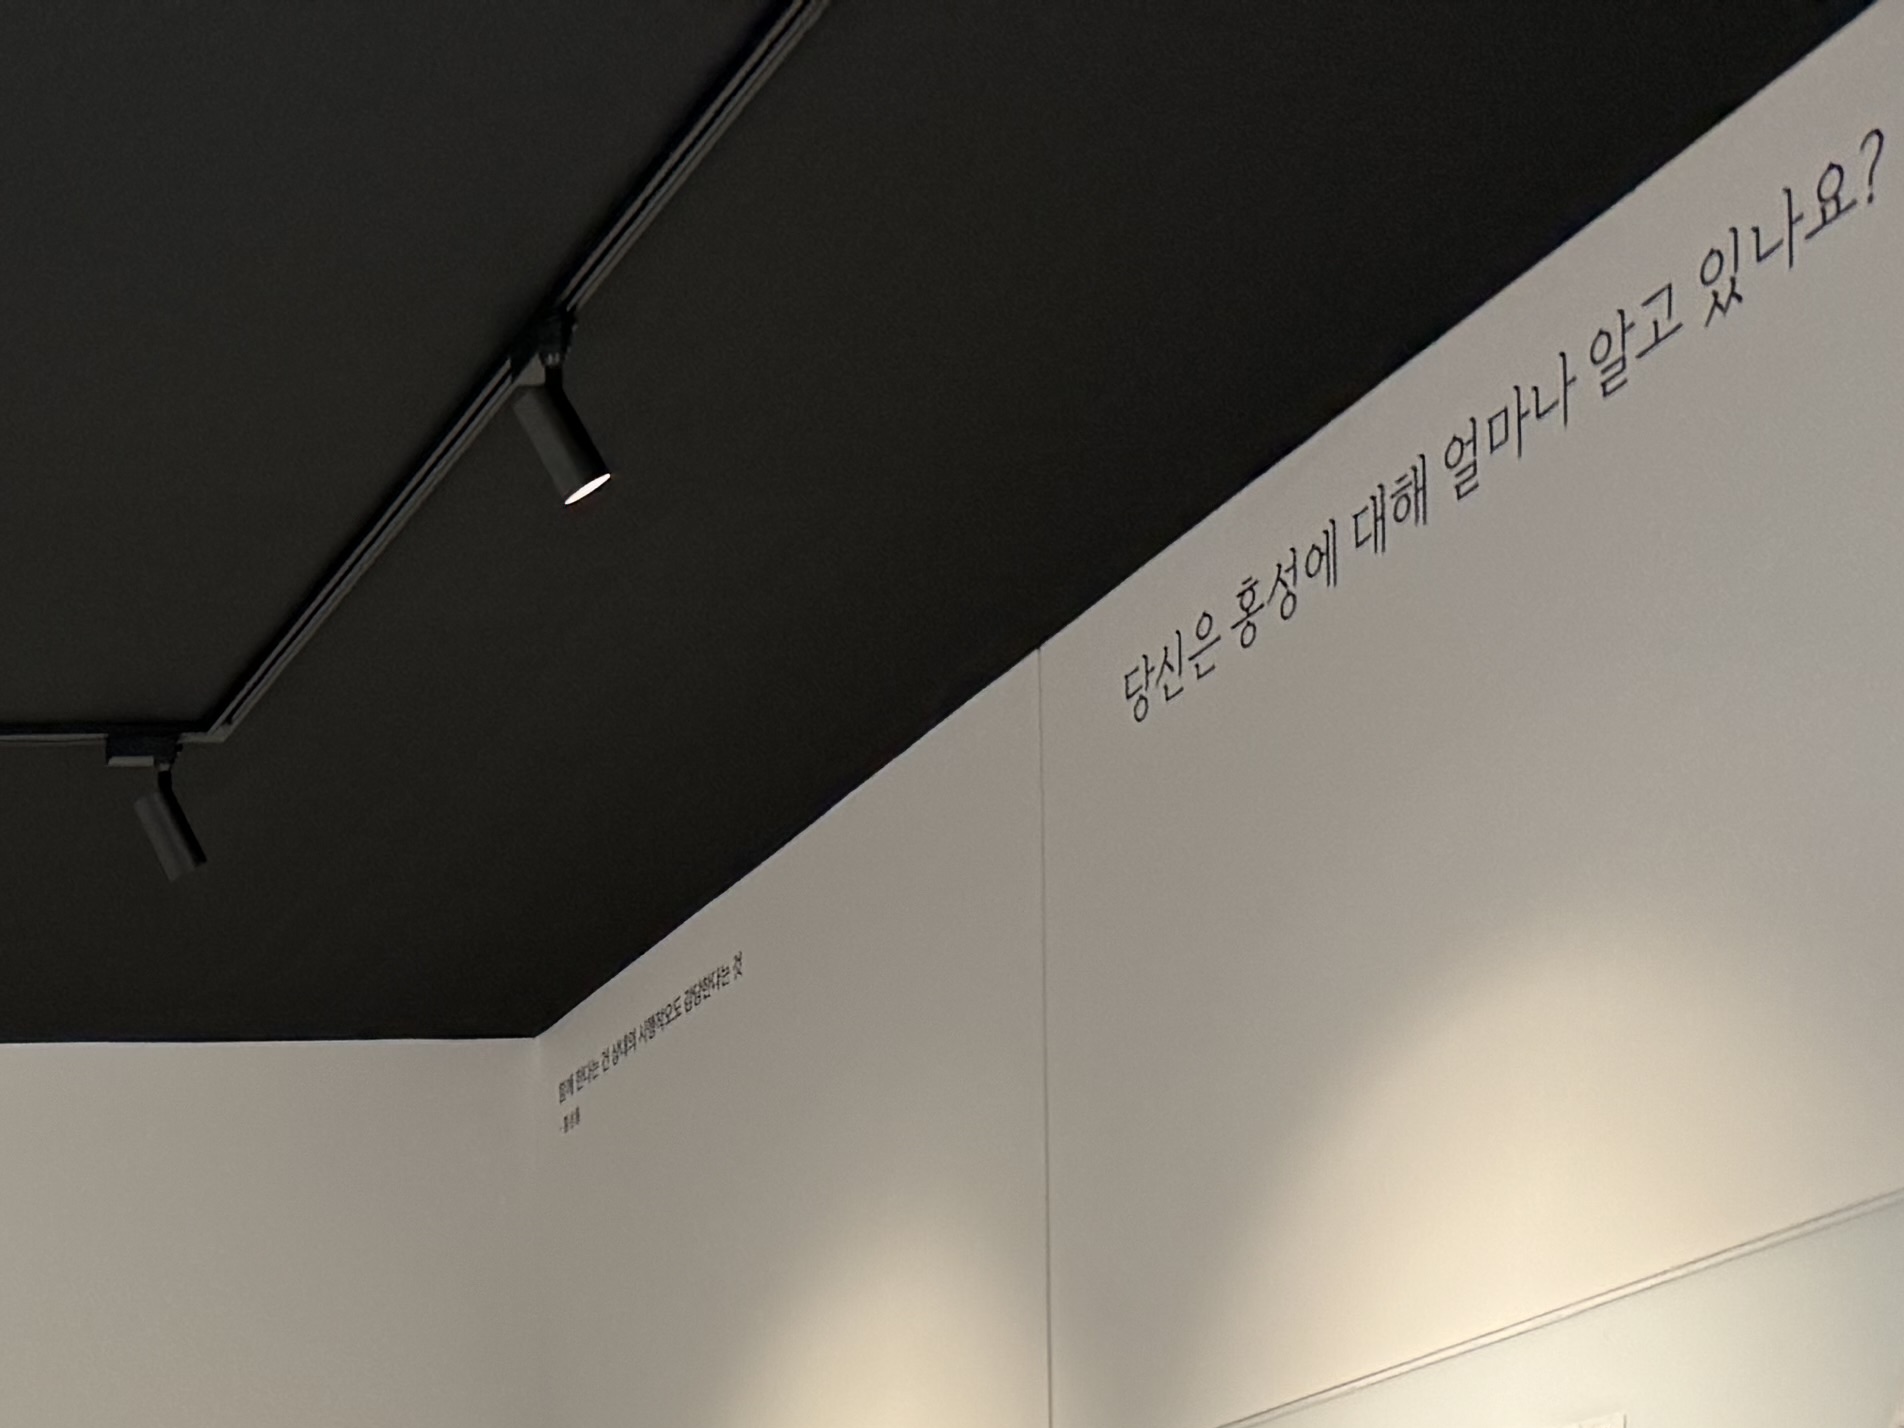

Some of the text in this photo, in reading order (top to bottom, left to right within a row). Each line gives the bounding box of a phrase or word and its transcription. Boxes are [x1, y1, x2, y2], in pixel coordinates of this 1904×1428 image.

[1124, 127, 1885, 722] 당신은 홍성에 대해 얼마나 알고 있나요?
